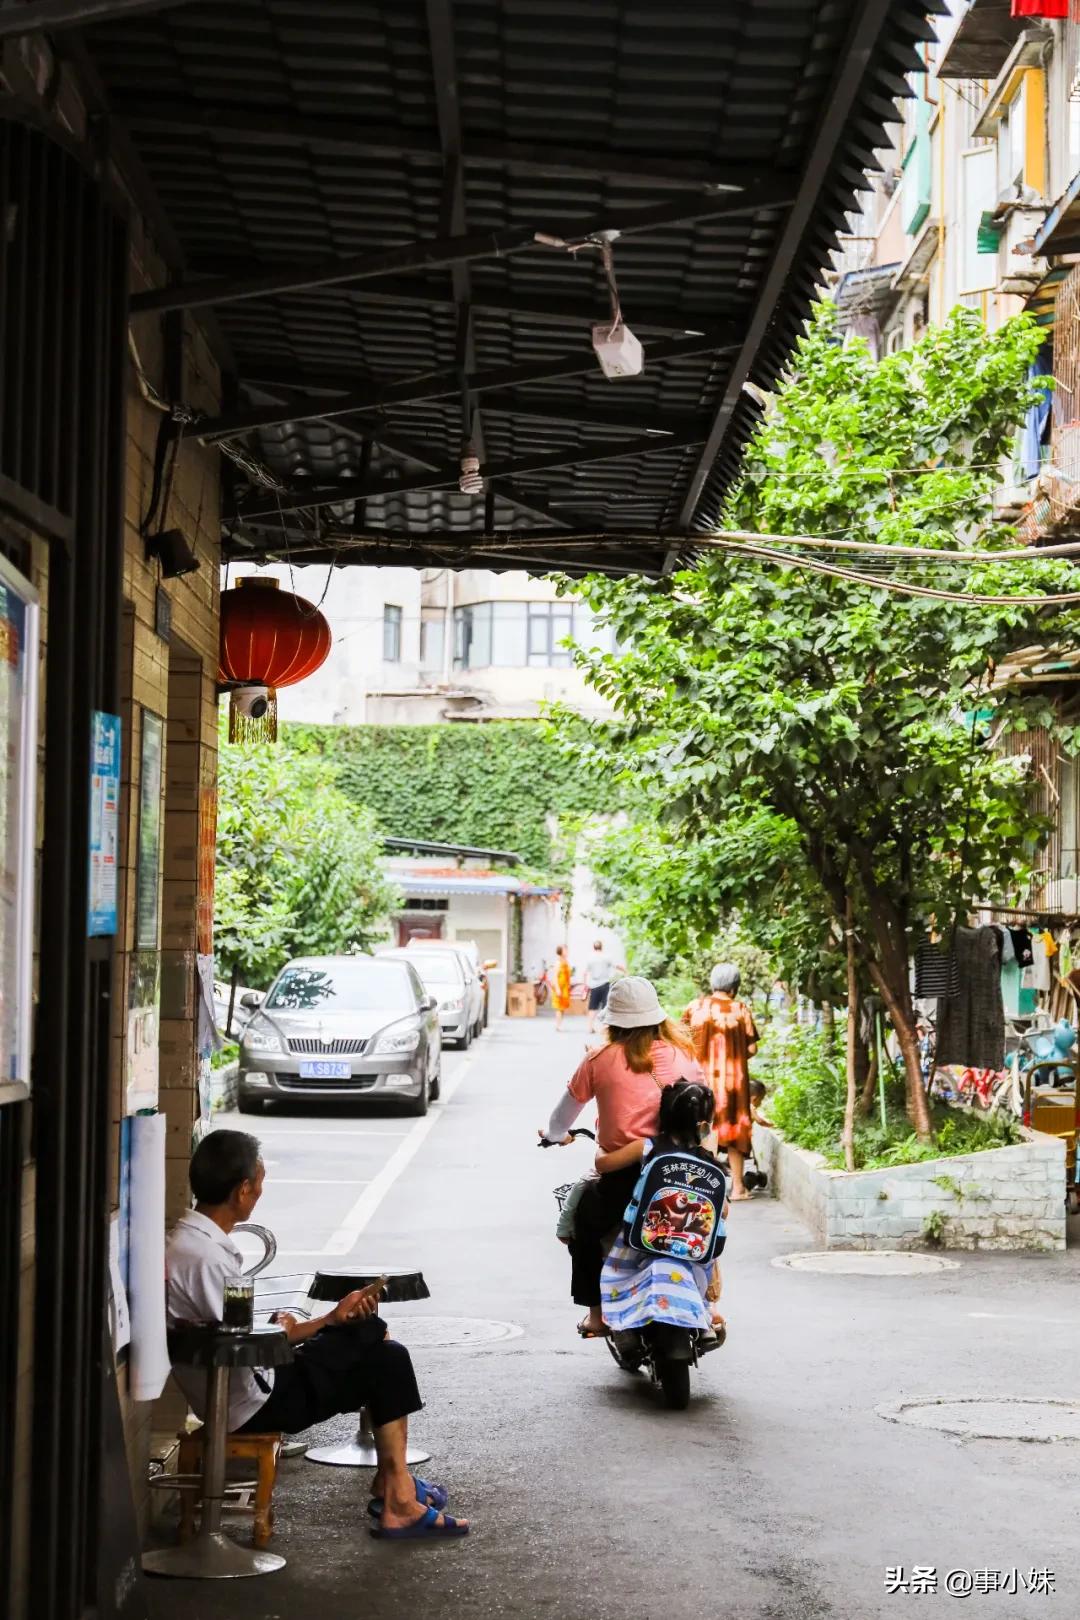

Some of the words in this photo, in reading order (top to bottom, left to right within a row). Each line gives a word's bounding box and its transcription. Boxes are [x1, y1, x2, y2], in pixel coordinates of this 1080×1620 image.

[661, 1162, 721, 1189] 玉林英艺幼儿园
